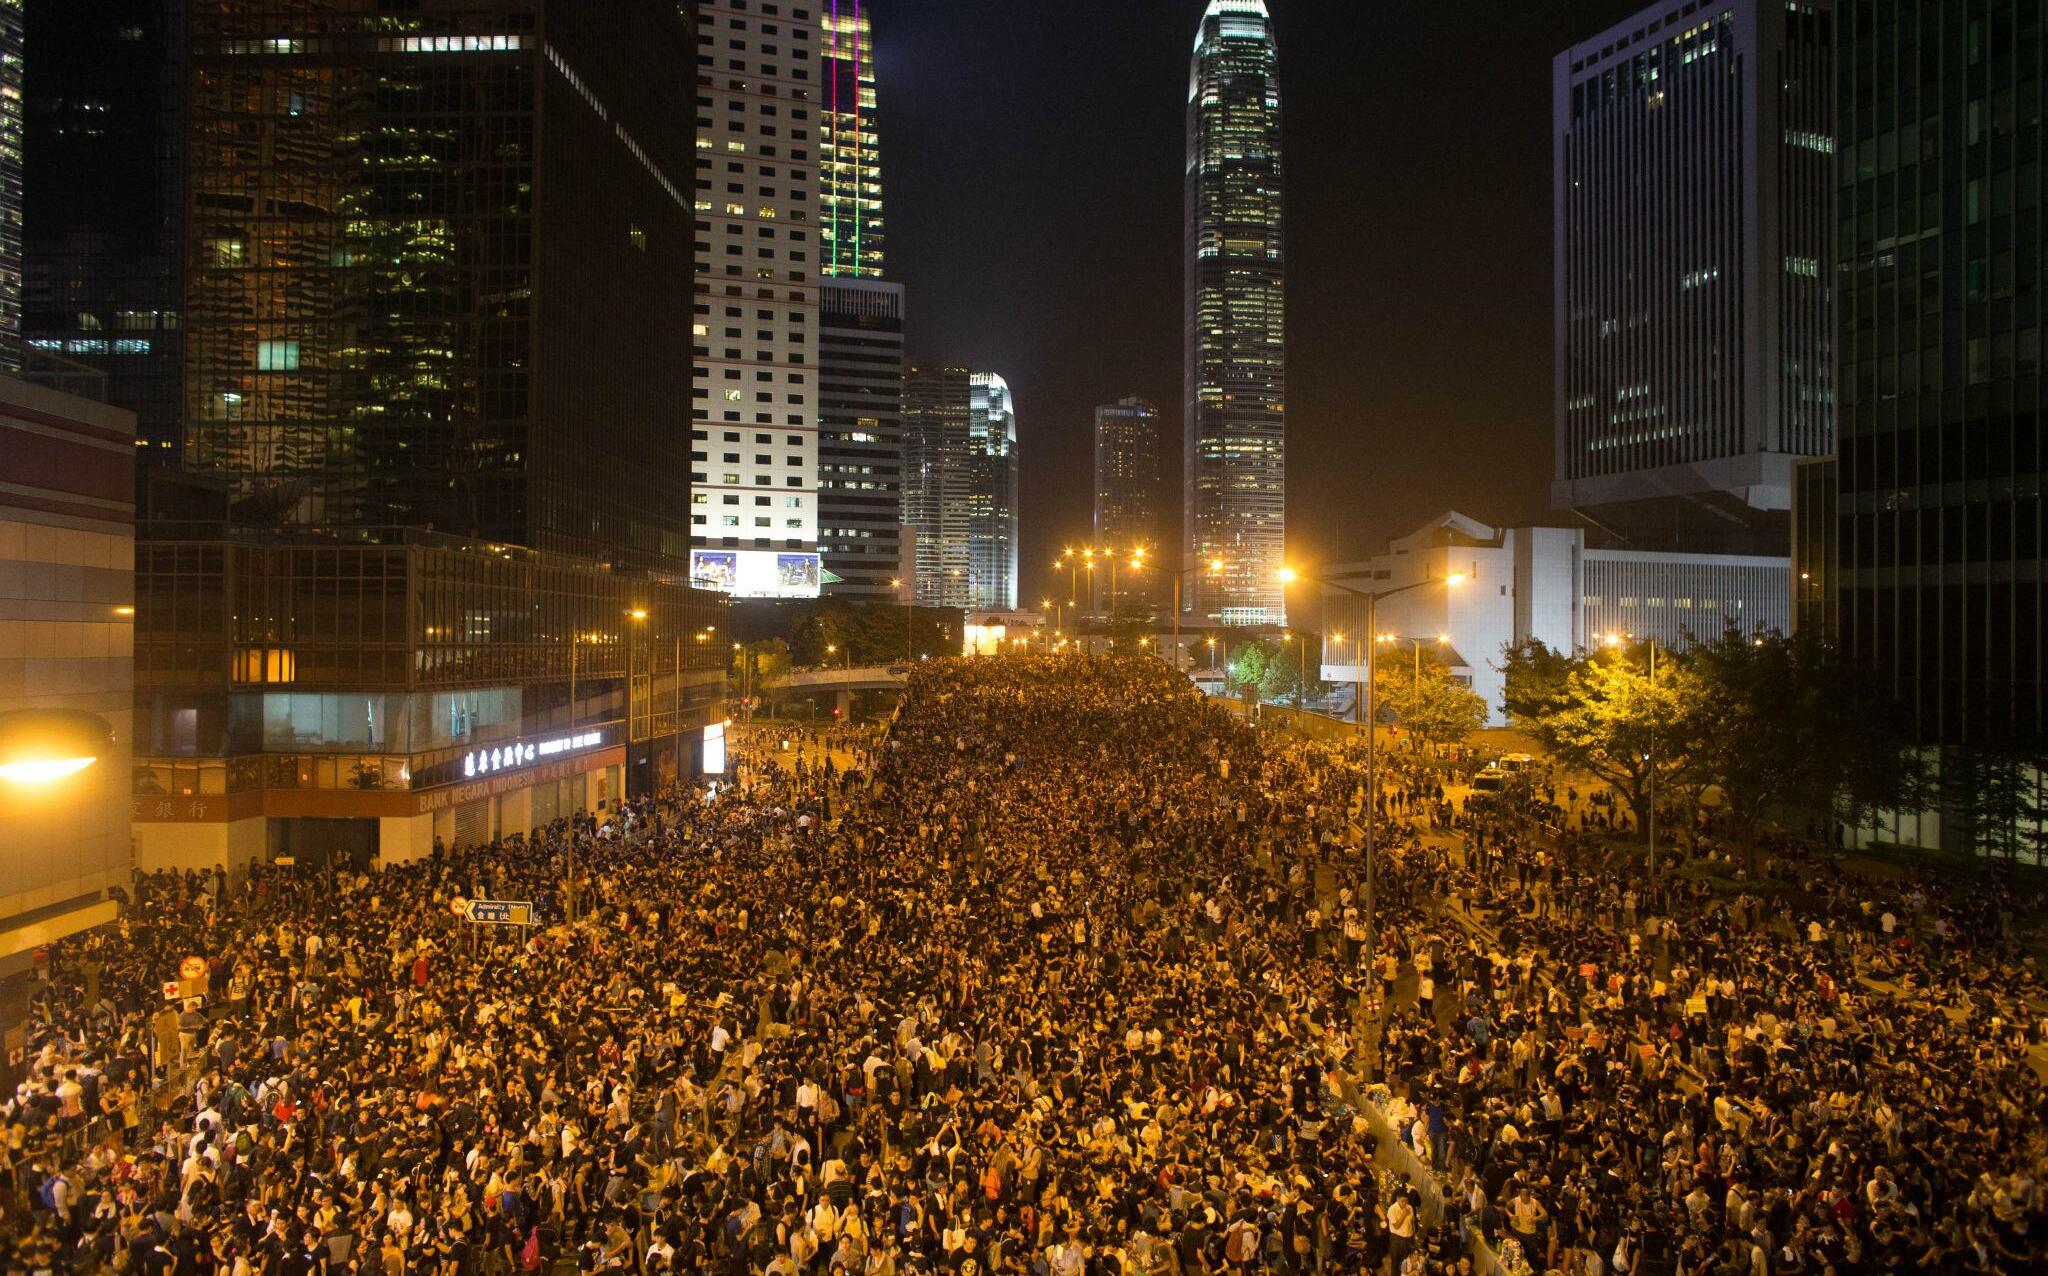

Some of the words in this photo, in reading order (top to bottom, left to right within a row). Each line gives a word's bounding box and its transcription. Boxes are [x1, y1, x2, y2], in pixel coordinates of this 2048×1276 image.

[420, 792, 449, 810] BANK
[452, 782, 490, 803] NEGARA
[493, 772, 535, 793] INDONESIA
